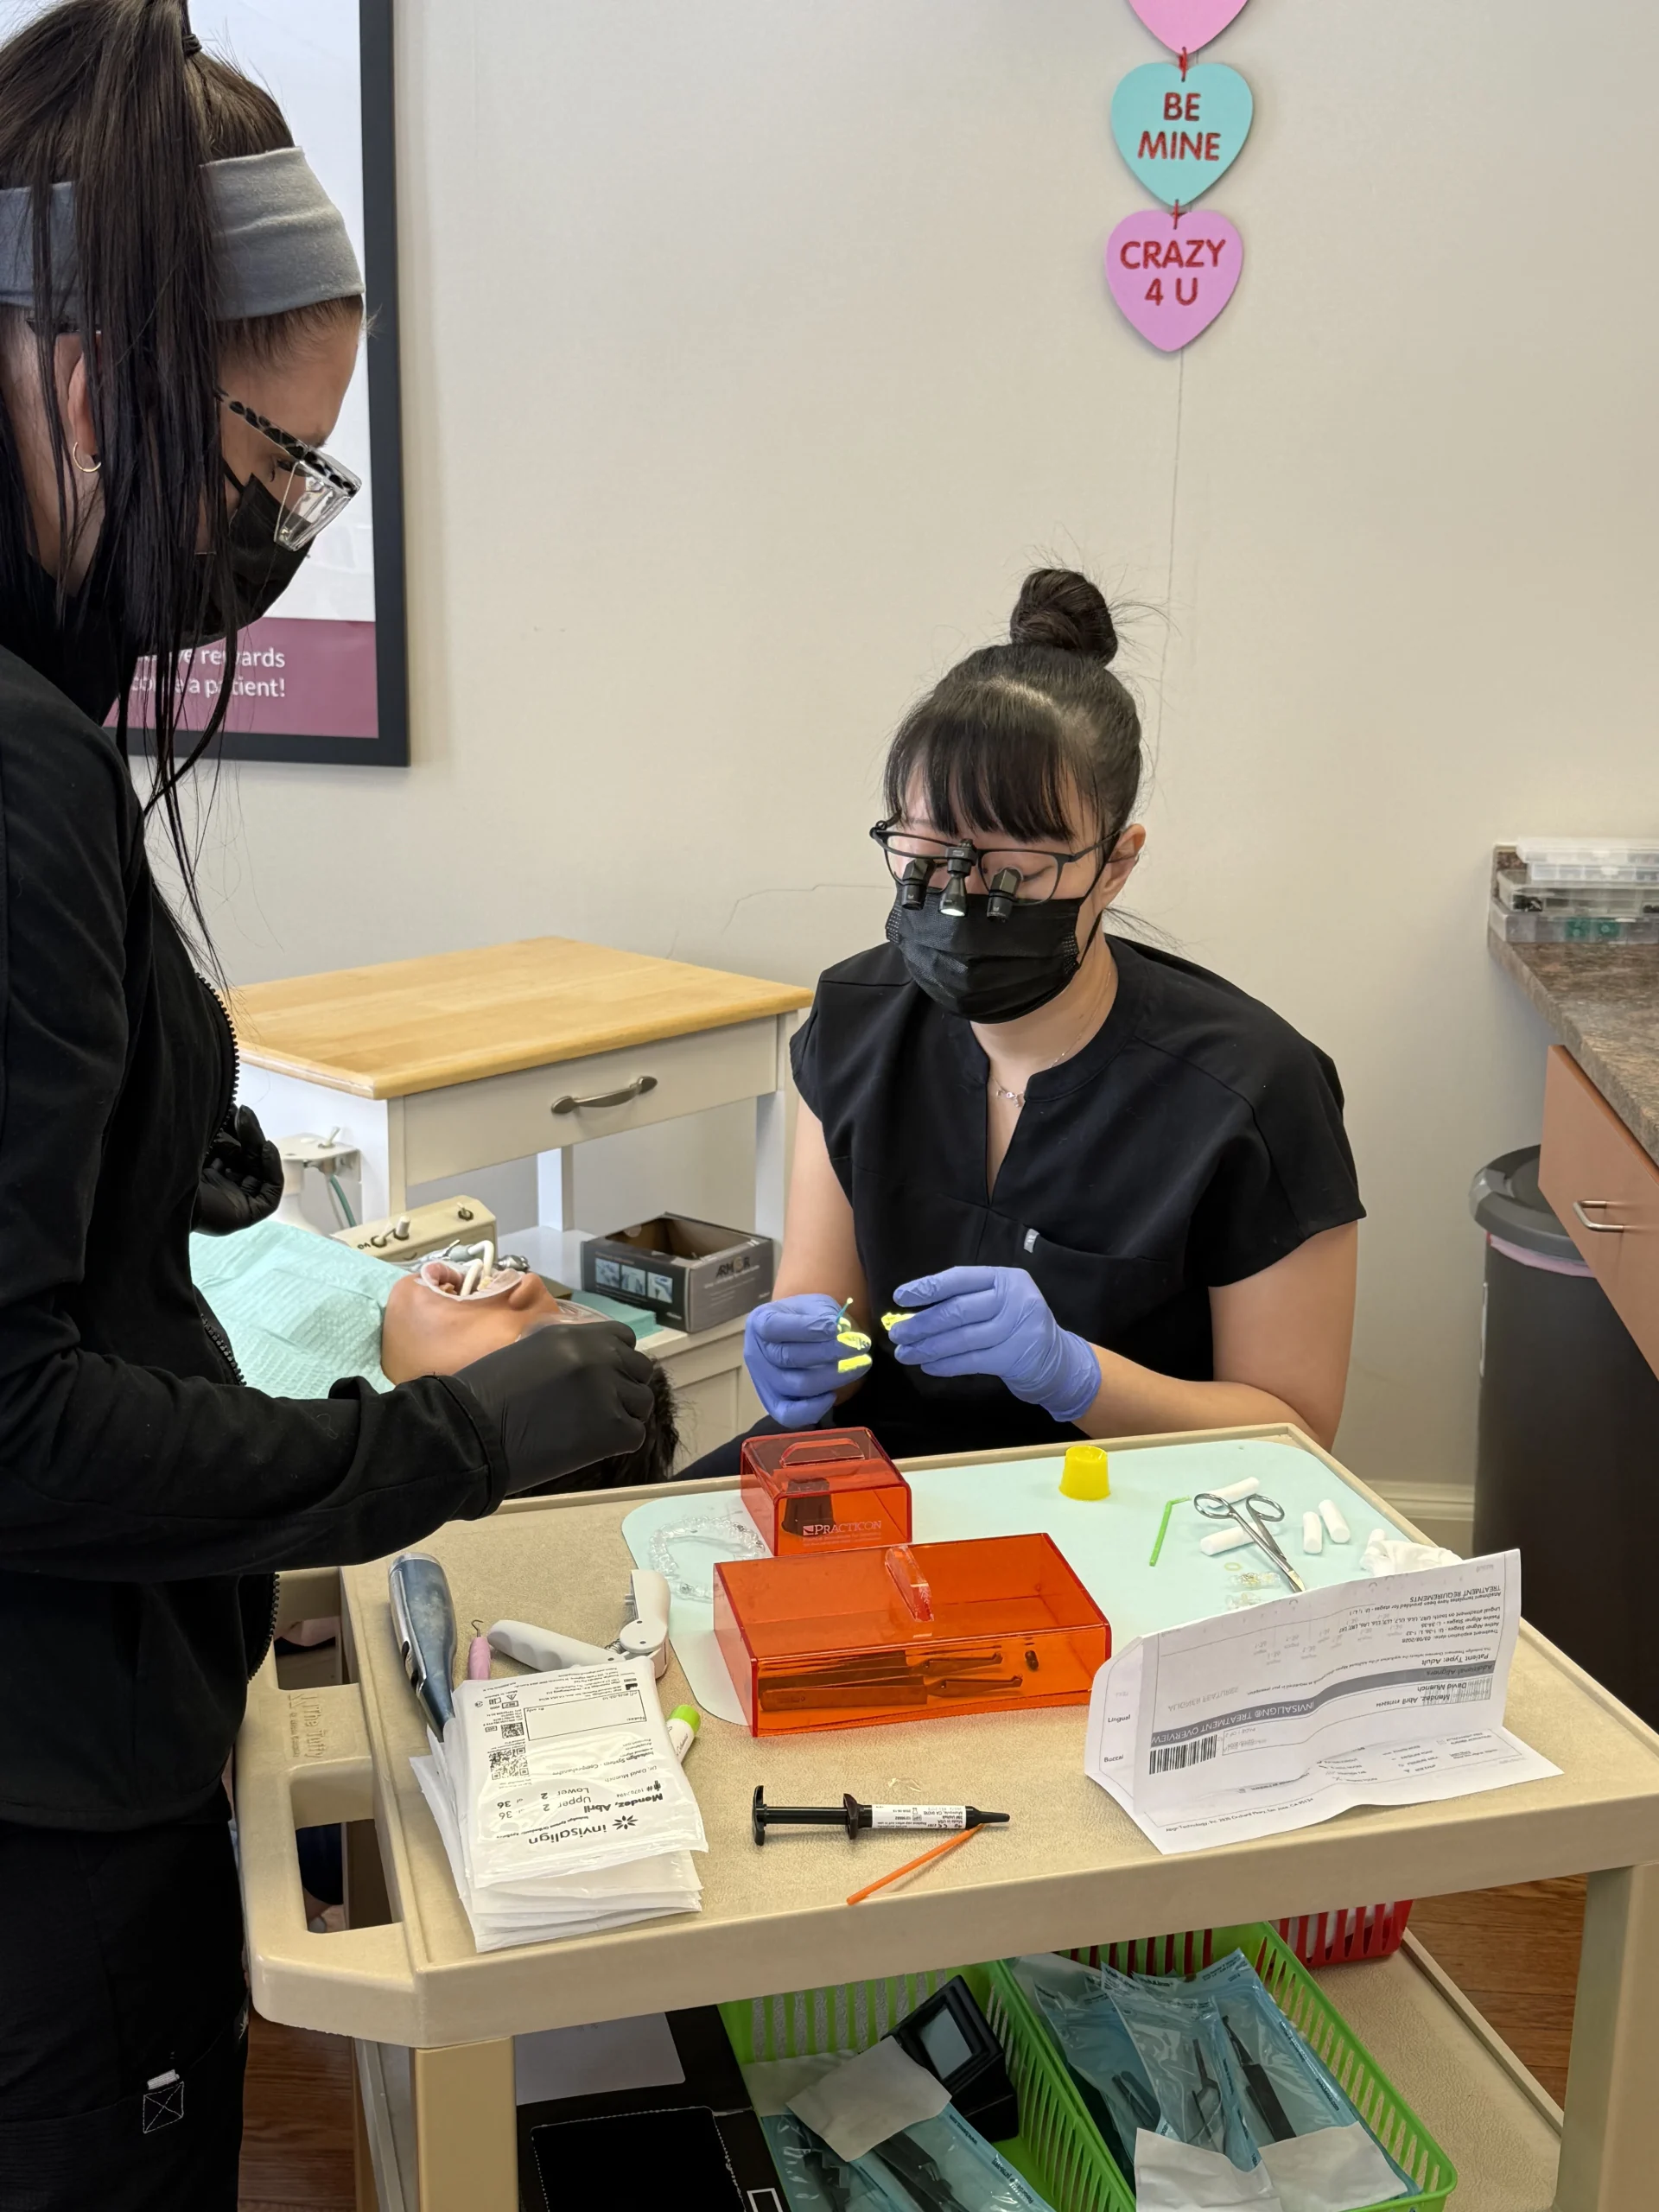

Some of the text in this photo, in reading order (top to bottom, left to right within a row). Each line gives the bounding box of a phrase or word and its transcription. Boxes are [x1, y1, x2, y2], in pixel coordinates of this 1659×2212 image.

[1163, 92, 1201, 122] BE
[1137, 131, 1221, 161] MINE
[1120, 238, 1226, 270] CRAZY
[1144, 277, 1198, 306] 4 U
[202, 647, 286, 668] reards
[189, 676, 286, 698] a ptient!
[815, 1521, 882, 1535] PRACTICON
[1410, 1586, 1500, 1602] TREATMENT REQUIREMENTS
[1465, 1653, 1489, 1662] Patient
[1458, 1665, 1492, 1675] Additional
[1108, 1714, 1131, 1724] Lingual
[1200, 1712, 1252, 1732] TREATMENT
[304, 1706, 326, 1758] The Tuffy
[1150, 1727, 1199, 1744] OVERVIEW
[1104, 1754, 1124, 1763] Buccal
[630, 1768, 646, 1777] David
[558, 1796, 591, 1808] Upper
[584, 1793, 663, 1813] Mendez, Abril
[499, 1810, 512, 1820] 36
[528, 1824, 607, 1845] invisalign
